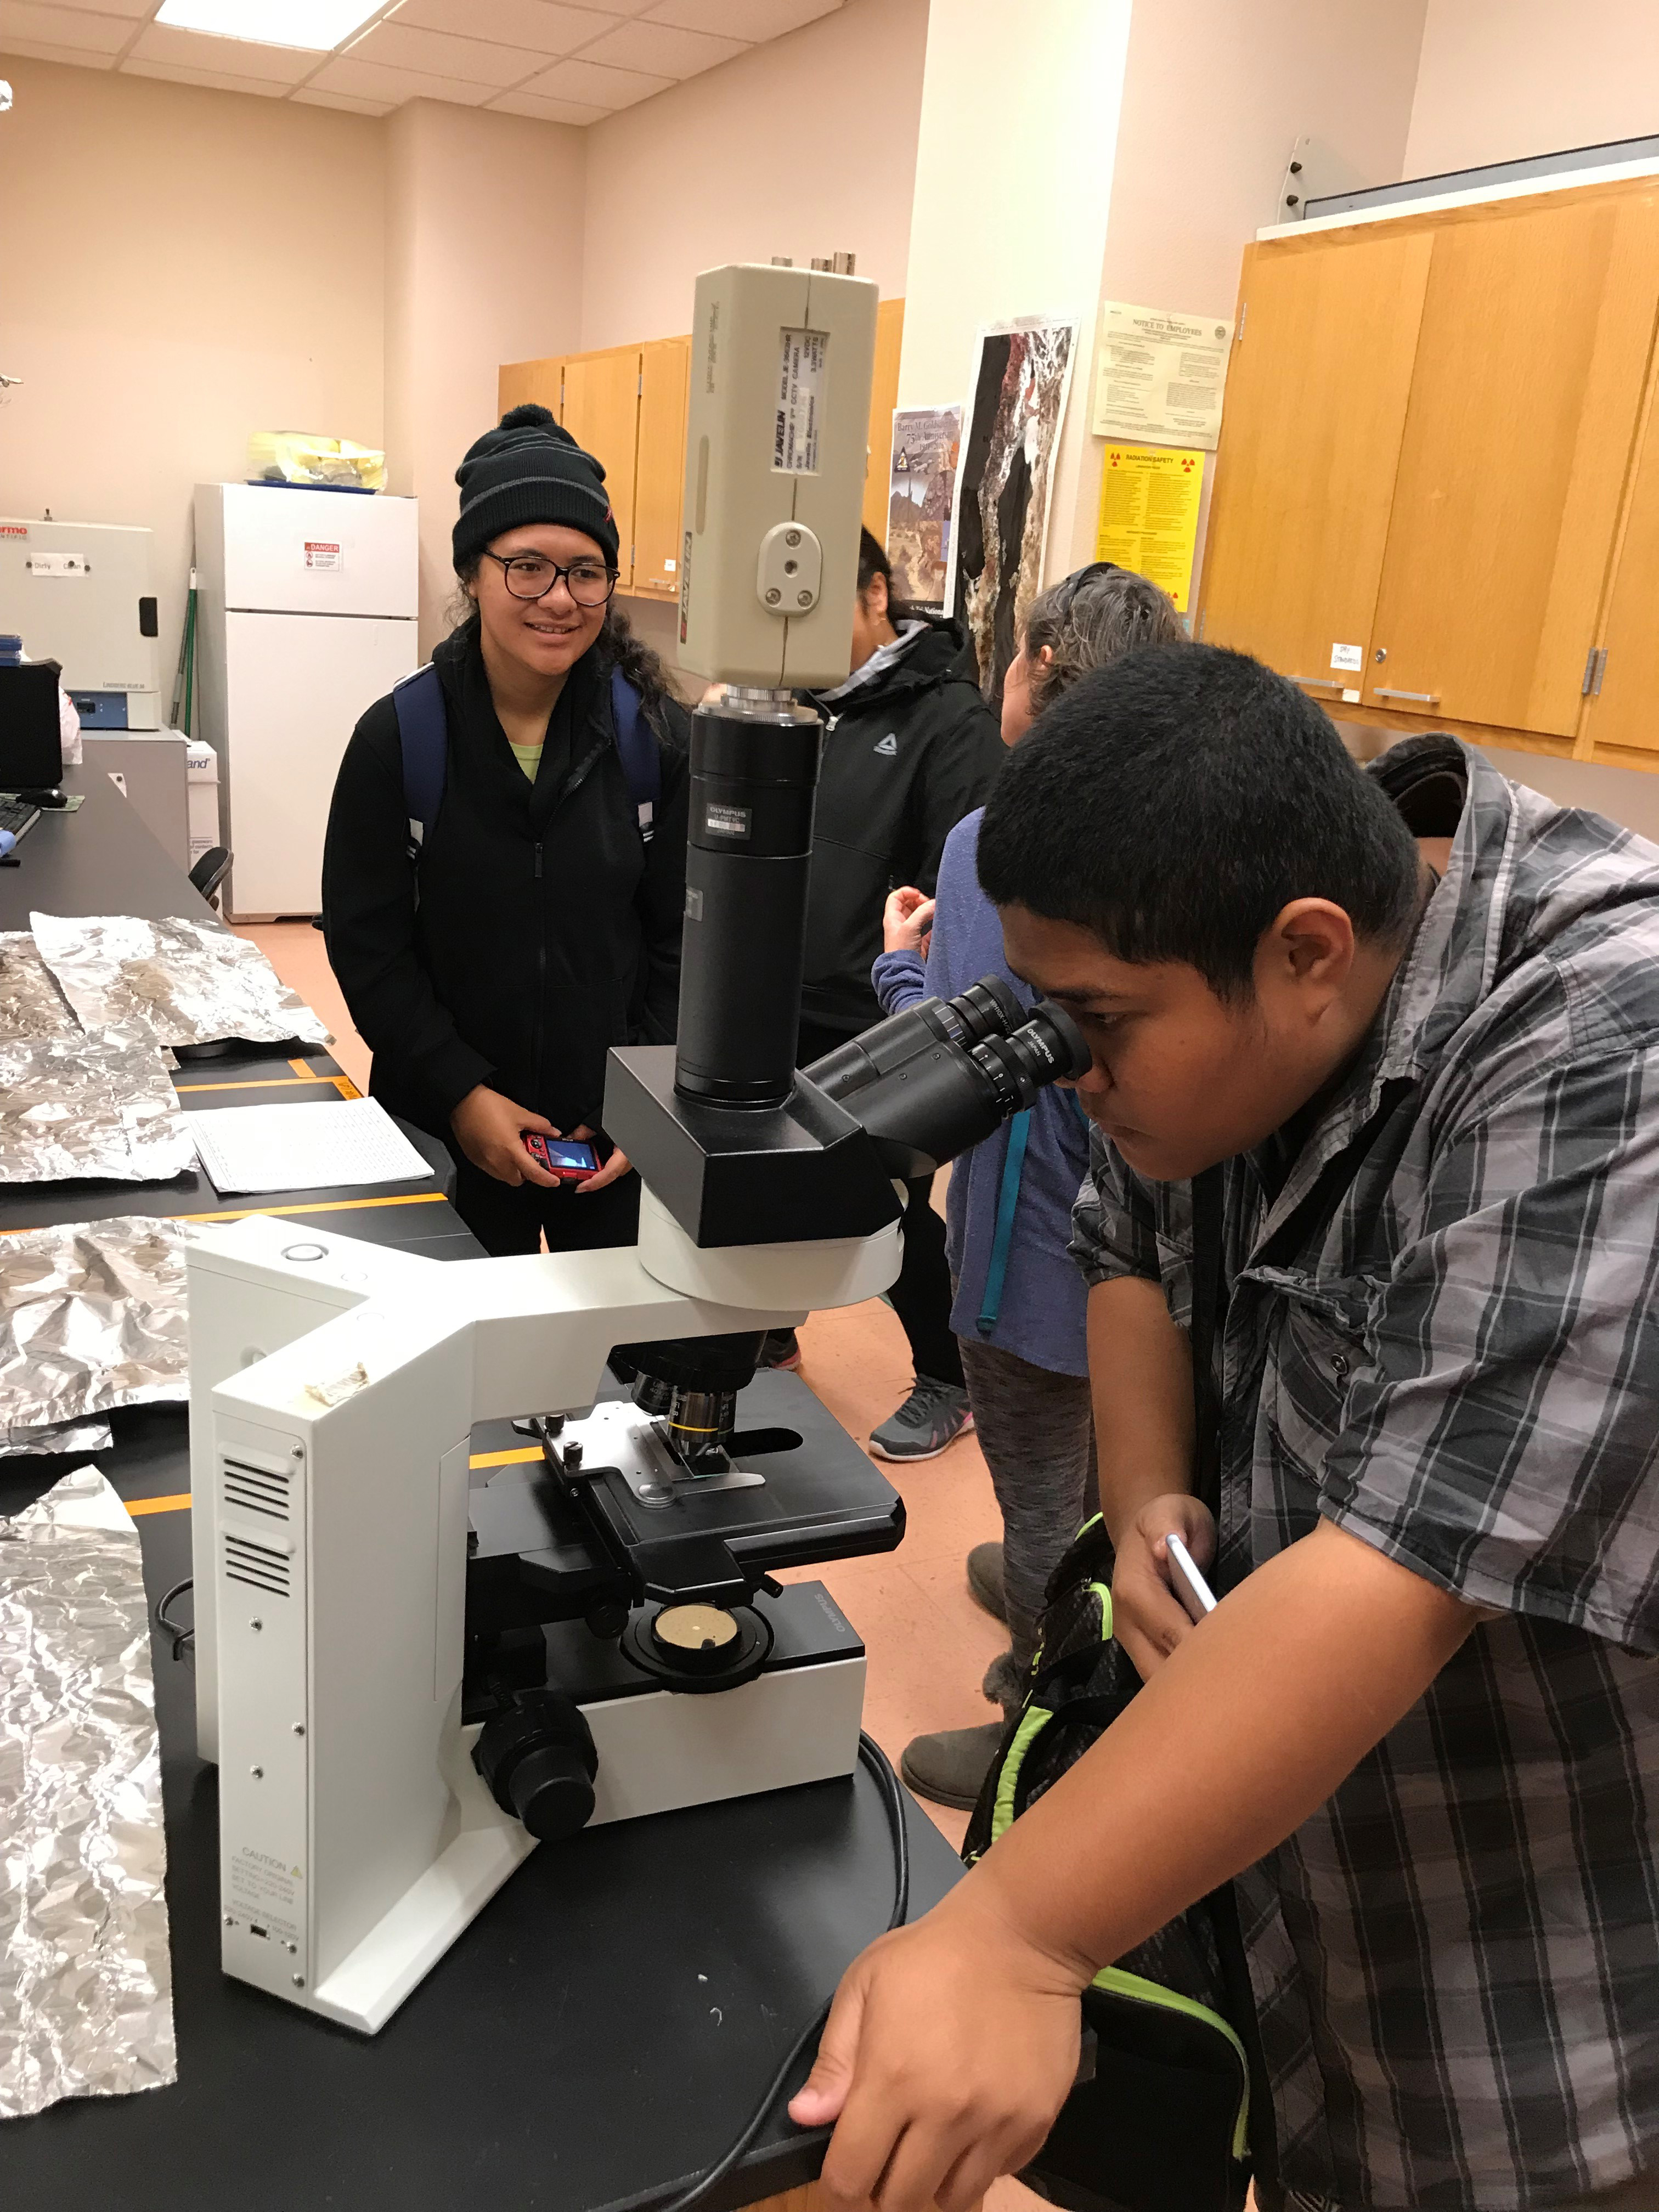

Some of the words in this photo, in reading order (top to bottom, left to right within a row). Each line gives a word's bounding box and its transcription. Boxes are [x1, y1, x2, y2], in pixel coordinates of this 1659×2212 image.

[1132, 319, 1155, 329] NOTICE
[1166, 324, 1203, 336] EMPLOYEES
[898, 421, 913, 432] Barry
[775, 409, 786, 457] JAVELIN
[906, 433, 921, 444] 75th
[1126, 454, 1152, 462] RADIATION
[0, 526, 27, 535] rmo
[310, 544, 339, 552] DANGER
[710, 806, 746, 818] OLYMPUS
[1027, 1028, 1054, 1064] OLYMPUS
[1028, 1041, 1041, 1057] JAPAN
[814, 1593, 846, 1633] OLYMPUS
[242, 1847, 286, 1871] CAUTION
[247, 1880, 257, 1889] TO
